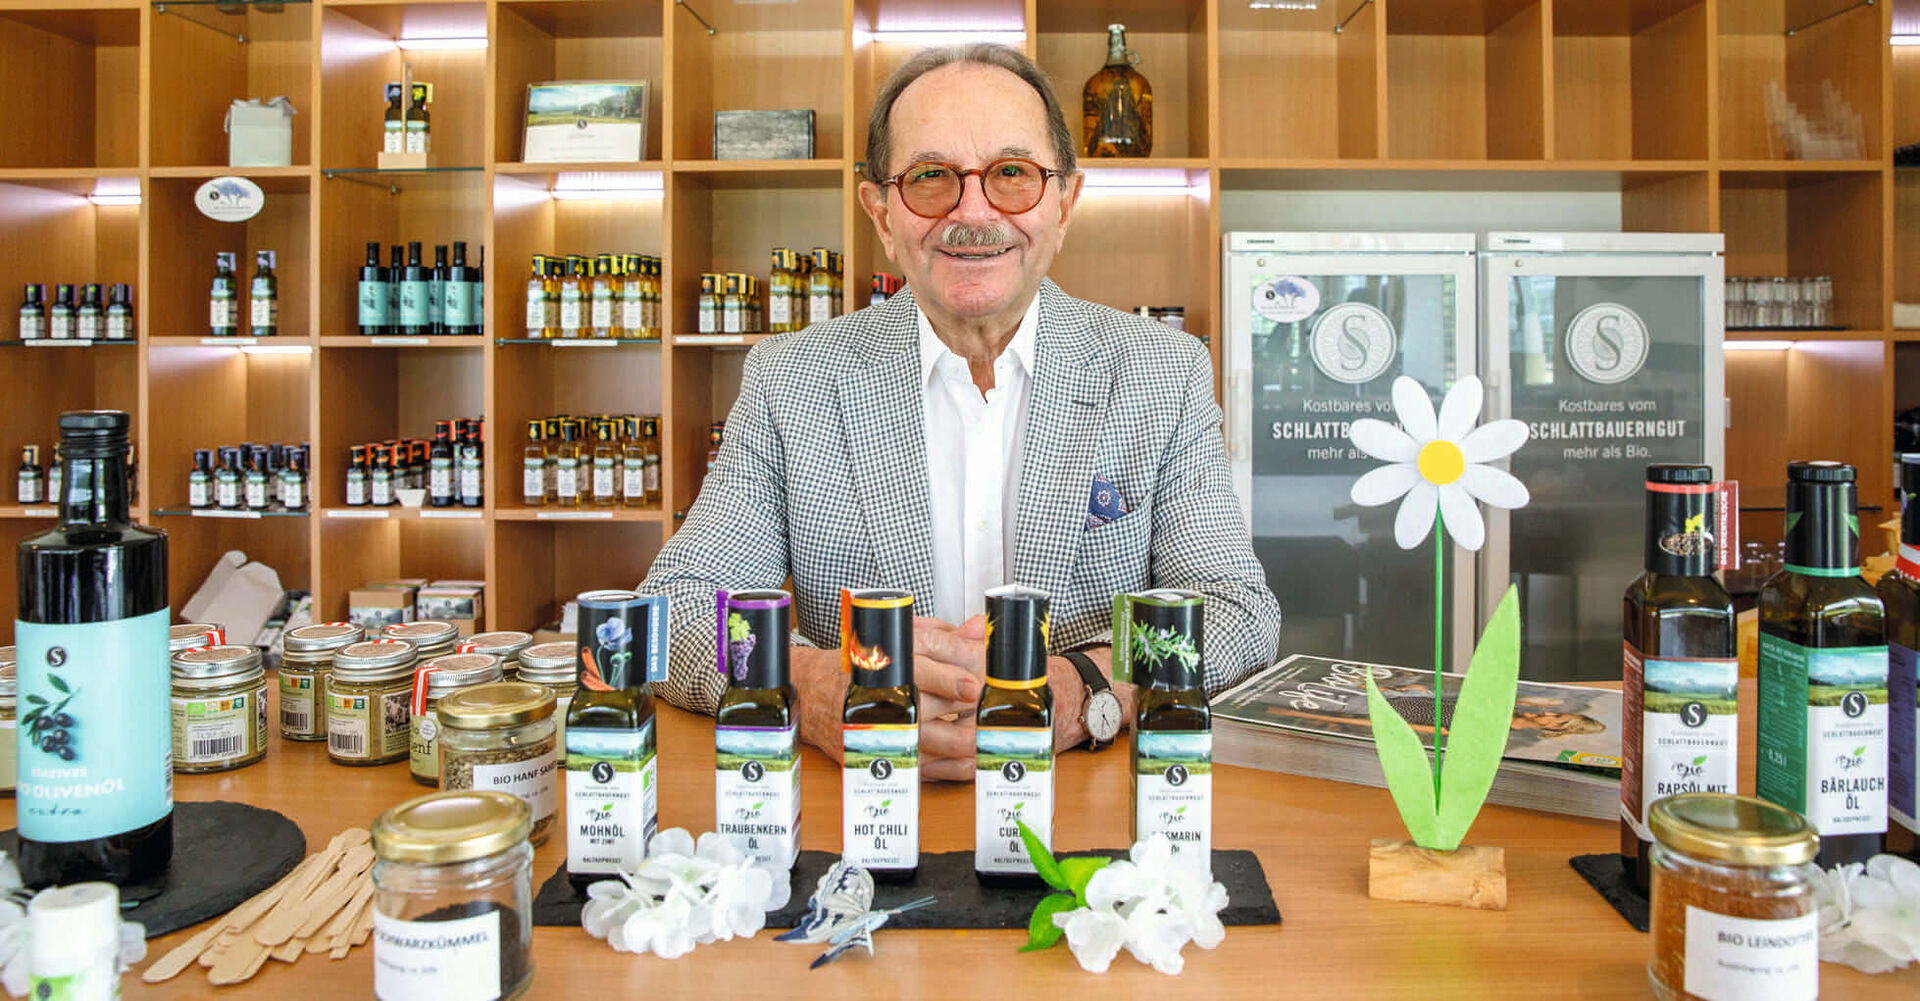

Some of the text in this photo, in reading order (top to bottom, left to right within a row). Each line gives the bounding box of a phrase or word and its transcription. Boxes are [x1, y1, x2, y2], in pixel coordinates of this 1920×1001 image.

[1303, 399, 1396, 413] Kostbares vo
[1558, 399, 1656, 413] Kostbares vom
[1530, 420, 1687, 440] SCHLATTBAUERNGUT
[1307, 447, 1367, 460] mehr als
[1563, 445, 1652, 459] mehr als Bio.
[493, 775, 511, 785] BIO
[513, 771, 538, 783] HANF
[33, 778, 127, 799] OLIVENÖL
[1657, 781, 1728, 795] RAPSÖL MIT
[1821, 777, 1886, 794] BÄRLAUCH
[1845, 794, 1860, 810] ÖL
[580, 823, 626, 838] MOHNÖL
[720, 823, 787, 836] TRAUBENKERN
[854, 824, 908, 836] HOT CHILI
[999, 826, 1023, 838] CUR
[1152, 831, 1201, 842] SMARIN
[748, 837, 759, 850] ÖL
[874, 836, 888, 850] ÖL
[1009, 838, 1021, 853] ÖL
[1717, 931, 1744, 946] BIO
